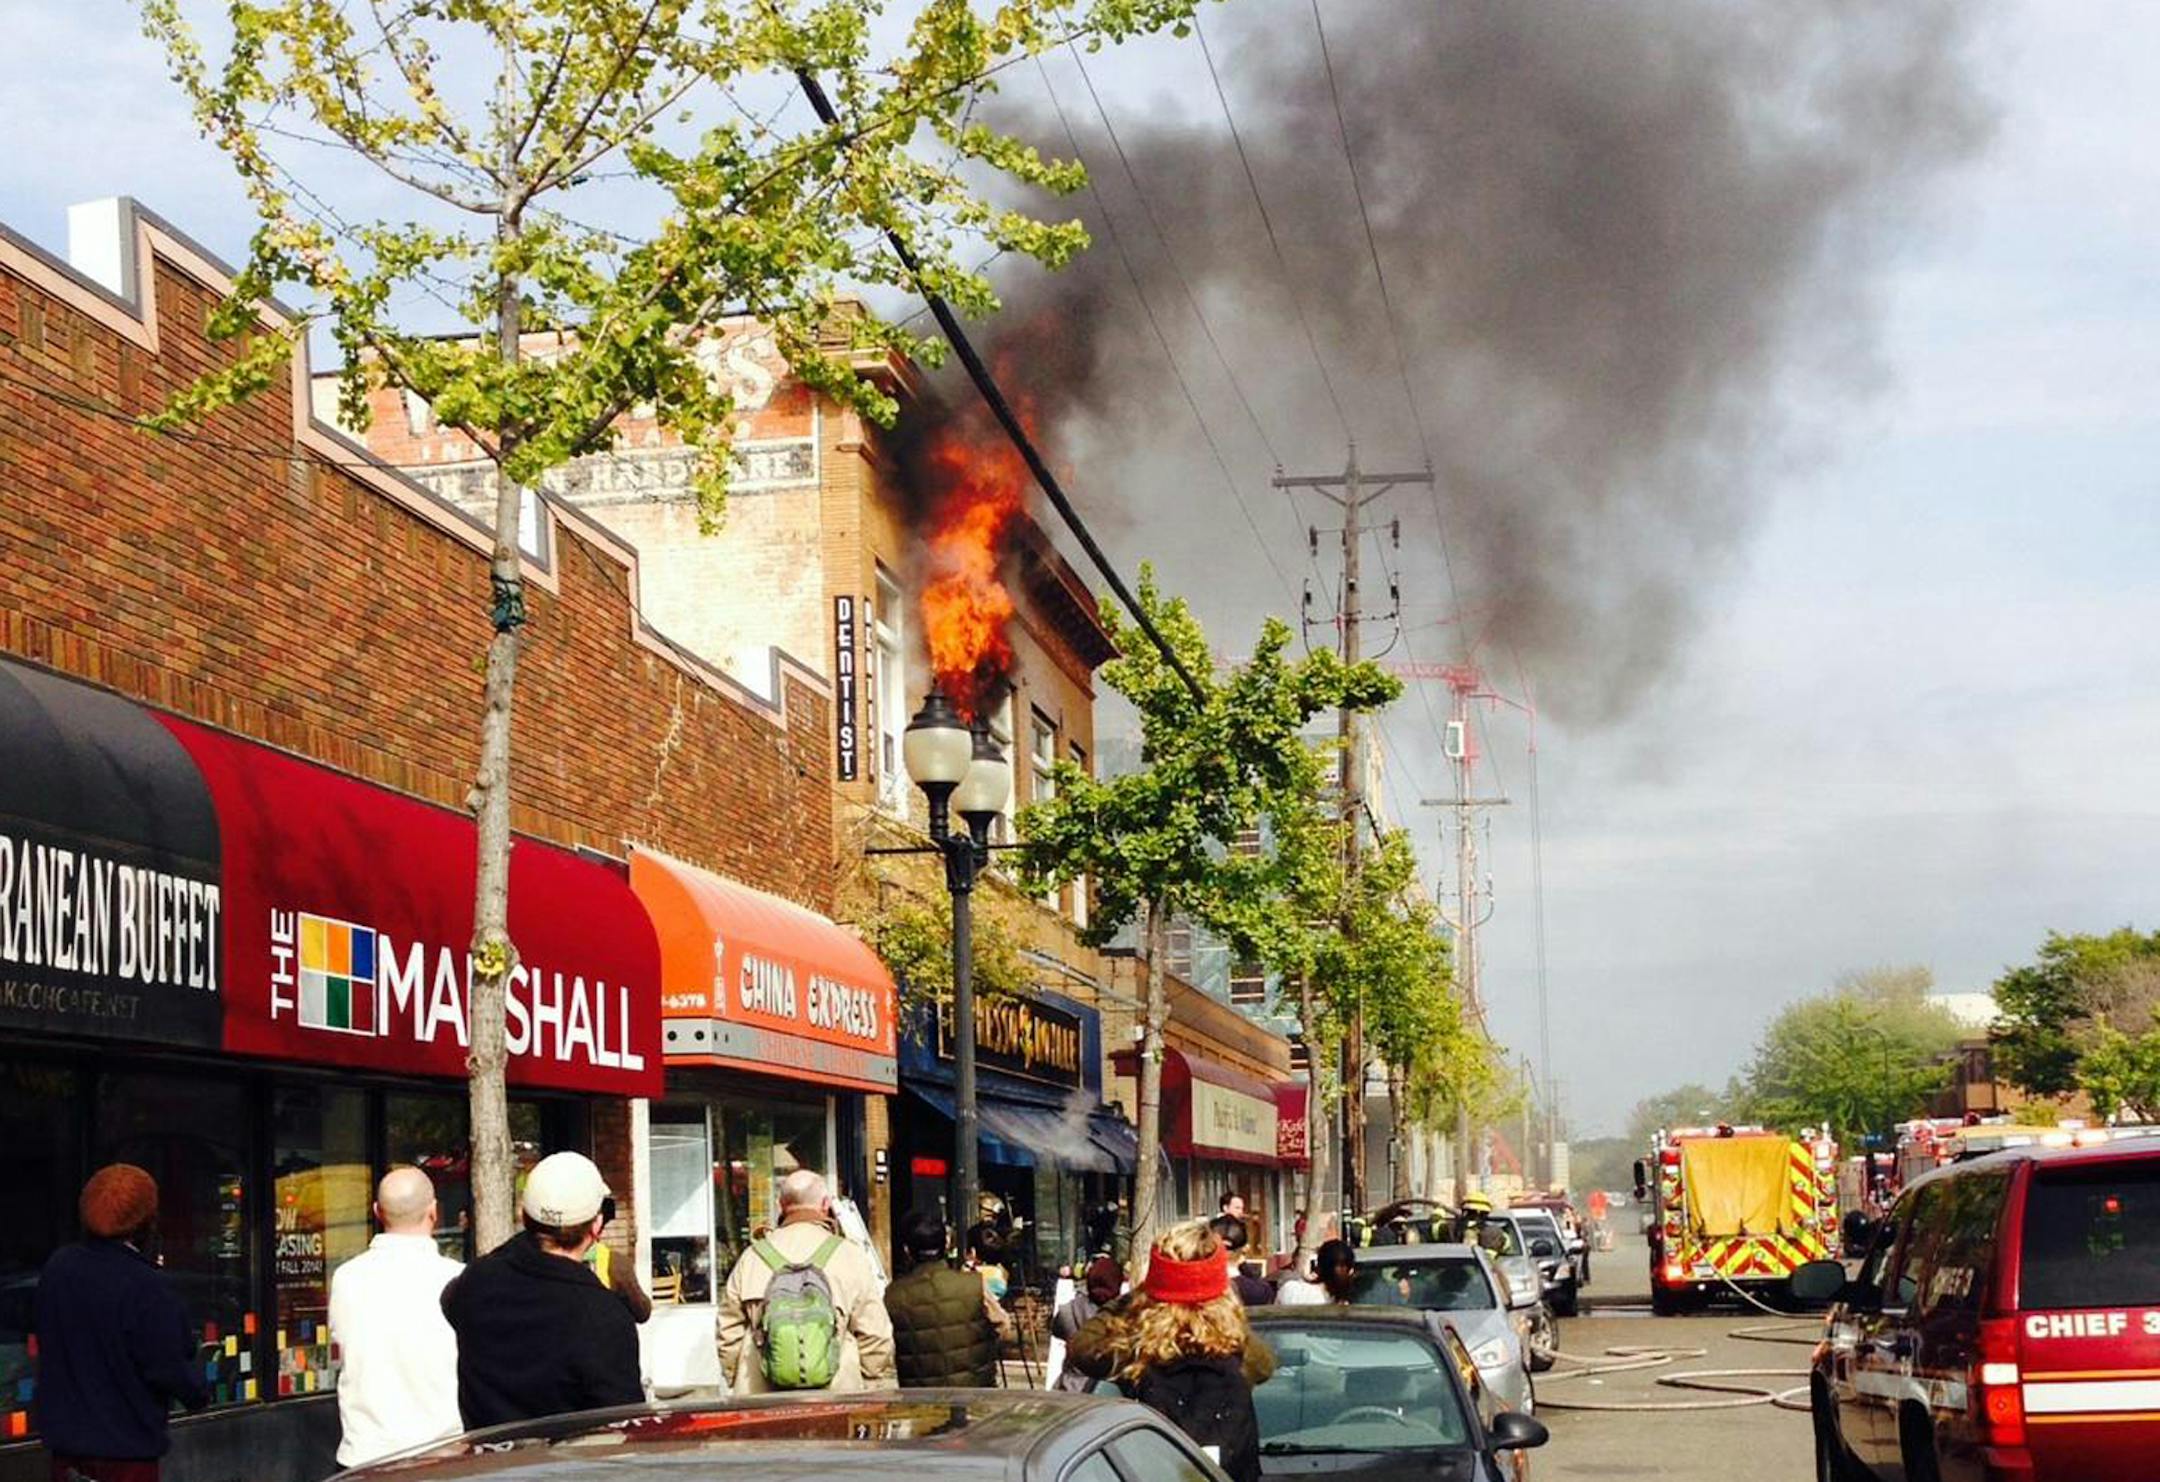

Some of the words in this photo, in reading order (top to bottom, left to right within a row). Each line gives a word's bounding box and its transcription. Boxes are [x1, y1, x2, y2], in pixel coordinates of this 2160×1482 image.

[590, 450, 793, 493] HARDARE
[837, 598, 853, 774] DENTIST
[118, 864, 220, 991] BUFFET
[271, 907, 294, 1020] THE
[379, 933, 645, 1071] MASHALL
[740, 953, 797, 1020] CHINA
[807, 974, 878, 1040] EXPRESS
[2024, 1312, 2128, 1339] CHIEF
